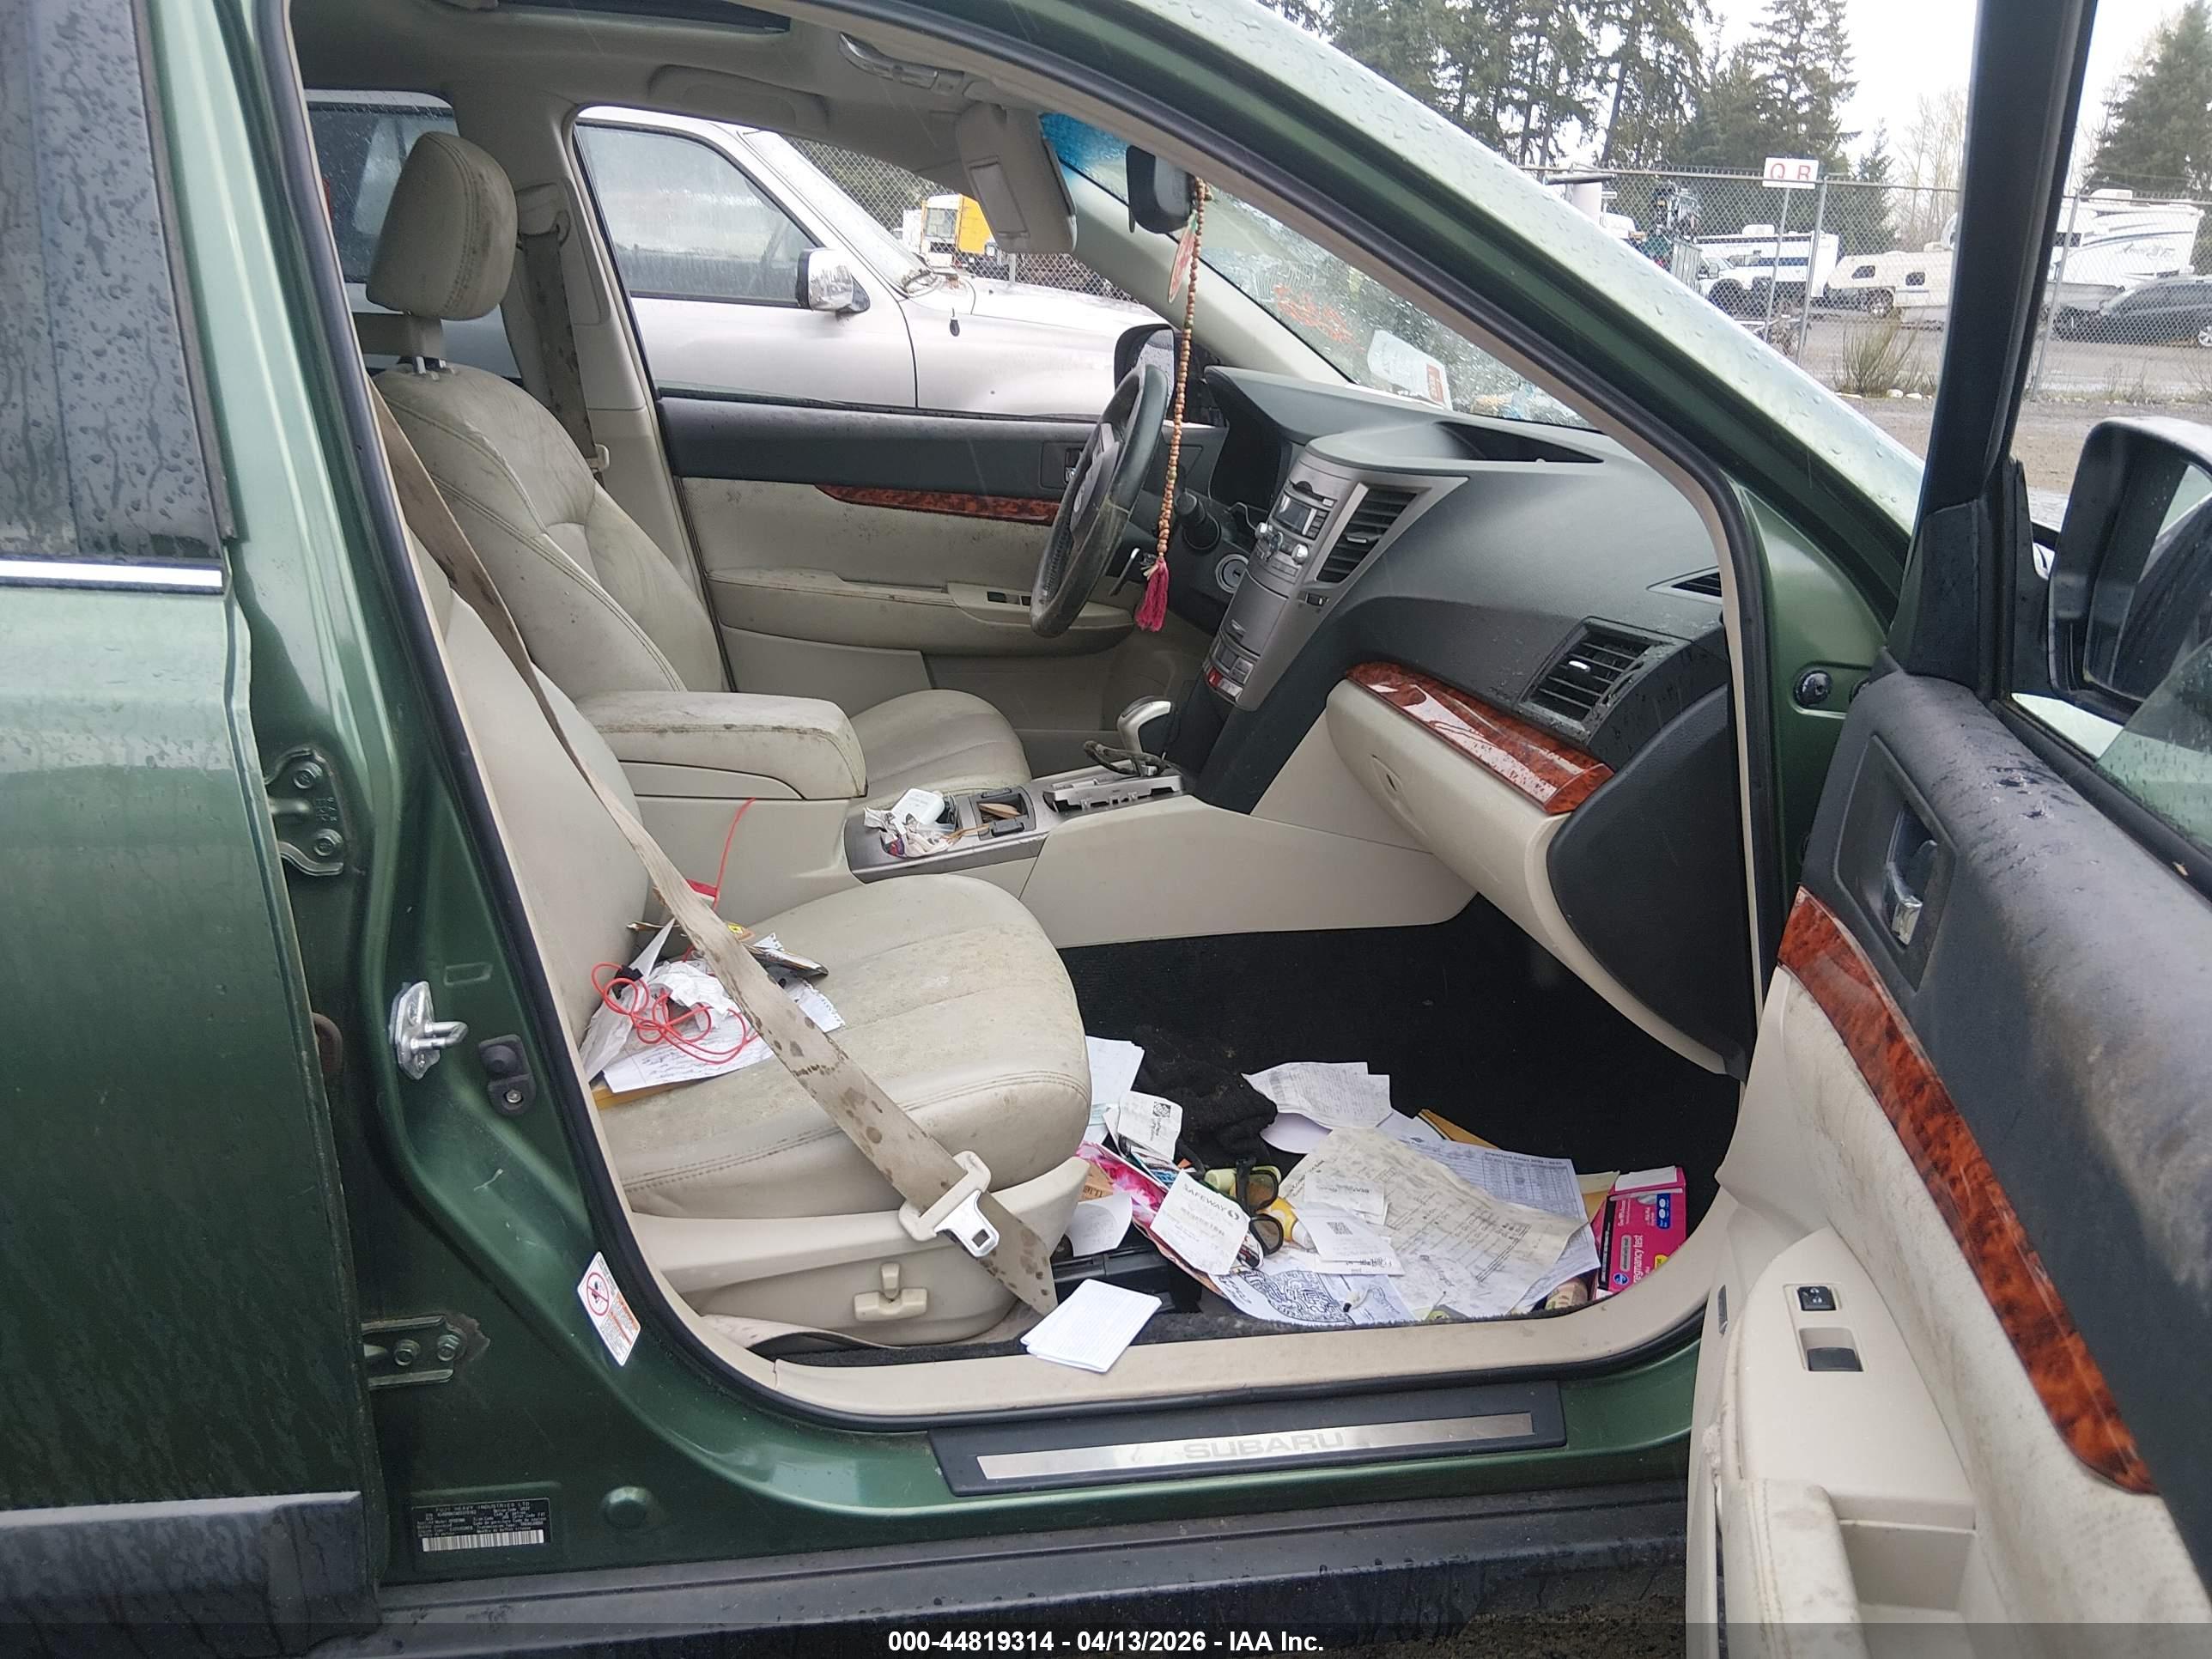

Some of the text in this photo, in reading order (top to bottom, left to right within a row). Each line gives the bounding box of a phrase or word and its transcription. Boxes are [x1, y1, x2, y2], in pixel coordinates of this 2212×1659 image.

[1182, 1183, 1227, 1212] SAFEWAY
[1632, 1234, 1644, 1282] regnancy test
[1183, 1431, 1344, 1459] SUBARU
